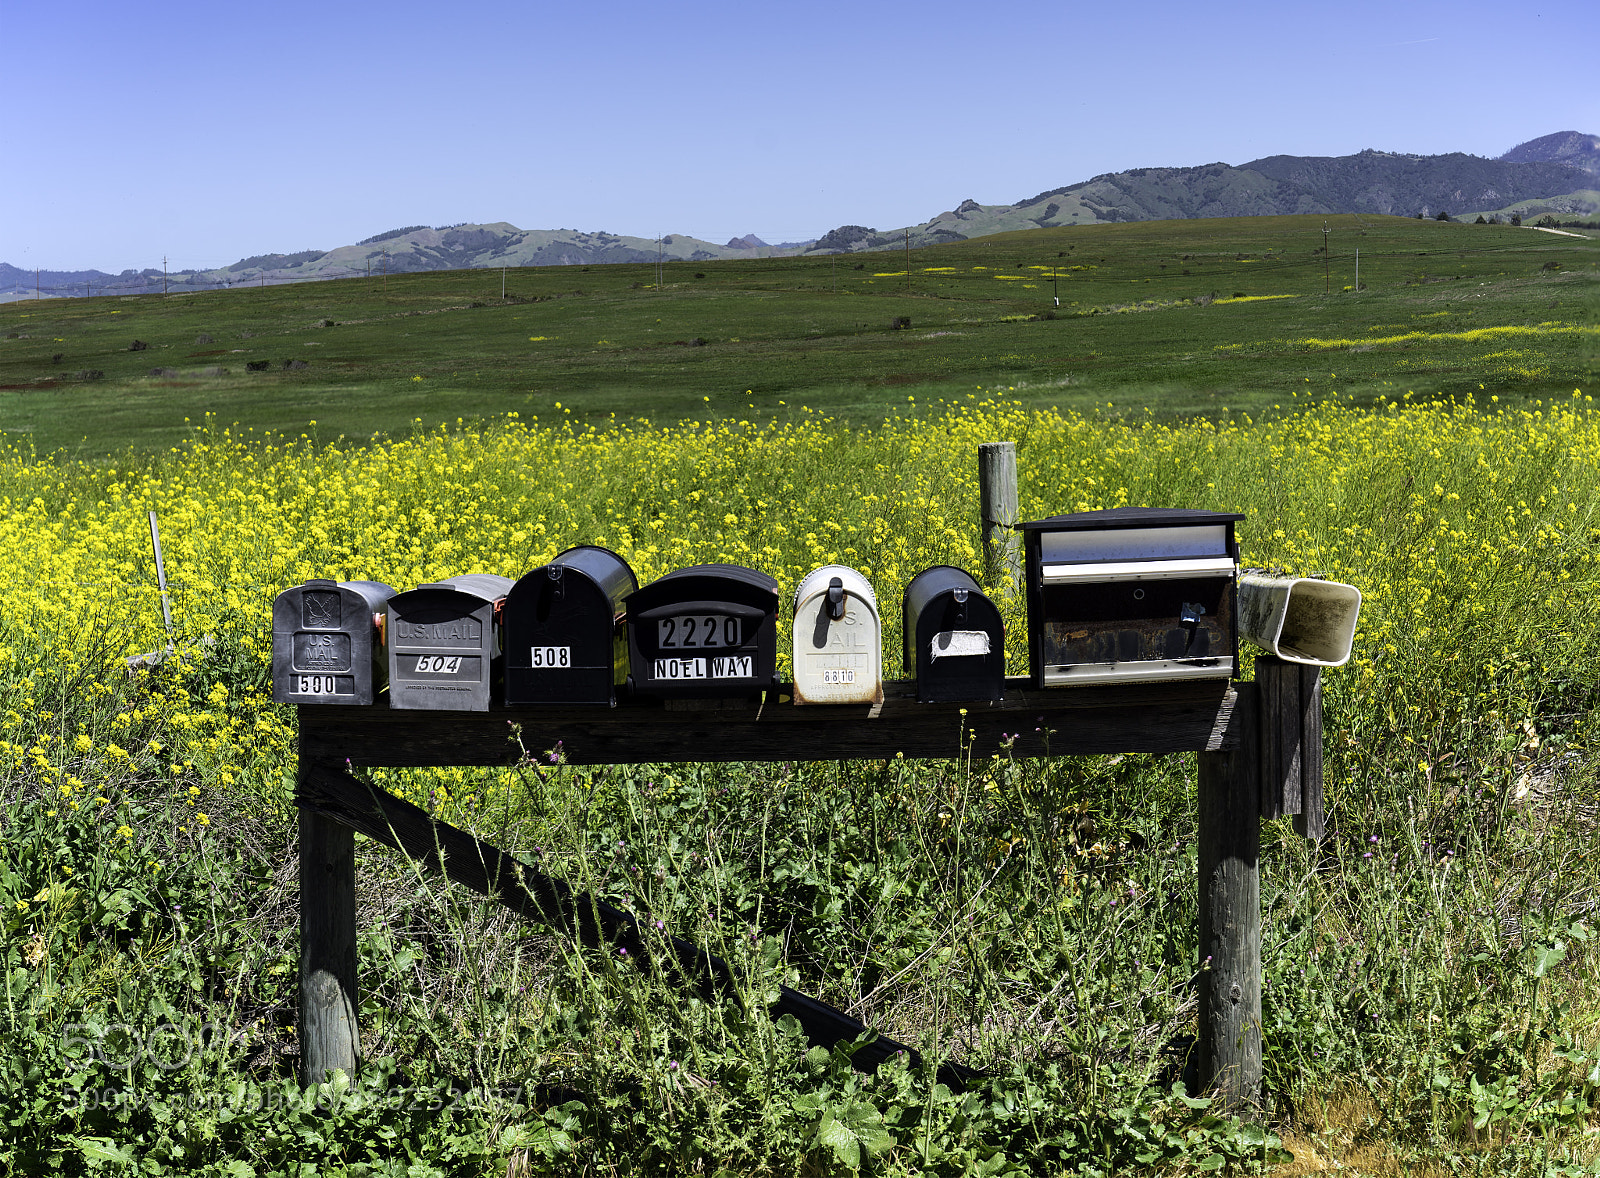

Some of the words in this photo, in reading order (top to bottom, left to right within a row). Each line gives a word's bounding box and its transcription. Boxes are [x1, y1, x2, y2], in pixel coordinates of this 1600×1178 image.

[309, 634, 335, 647] U.S.
[398, 622, 430, 640] U.S.
[432, 624, 480, 641] MAIL
[662, 617, 738, 648] 2220
[305, 647, 338, 660] MAIL
[534, 647, 567, 666] 508
[418, 655, 459, 672] 504
[656, 659, 704, 678] NOEL
[714, 657, 750, 677] WAY
[301, 675, 334, 693] 500
[824, 670, 854, 682] 8810
